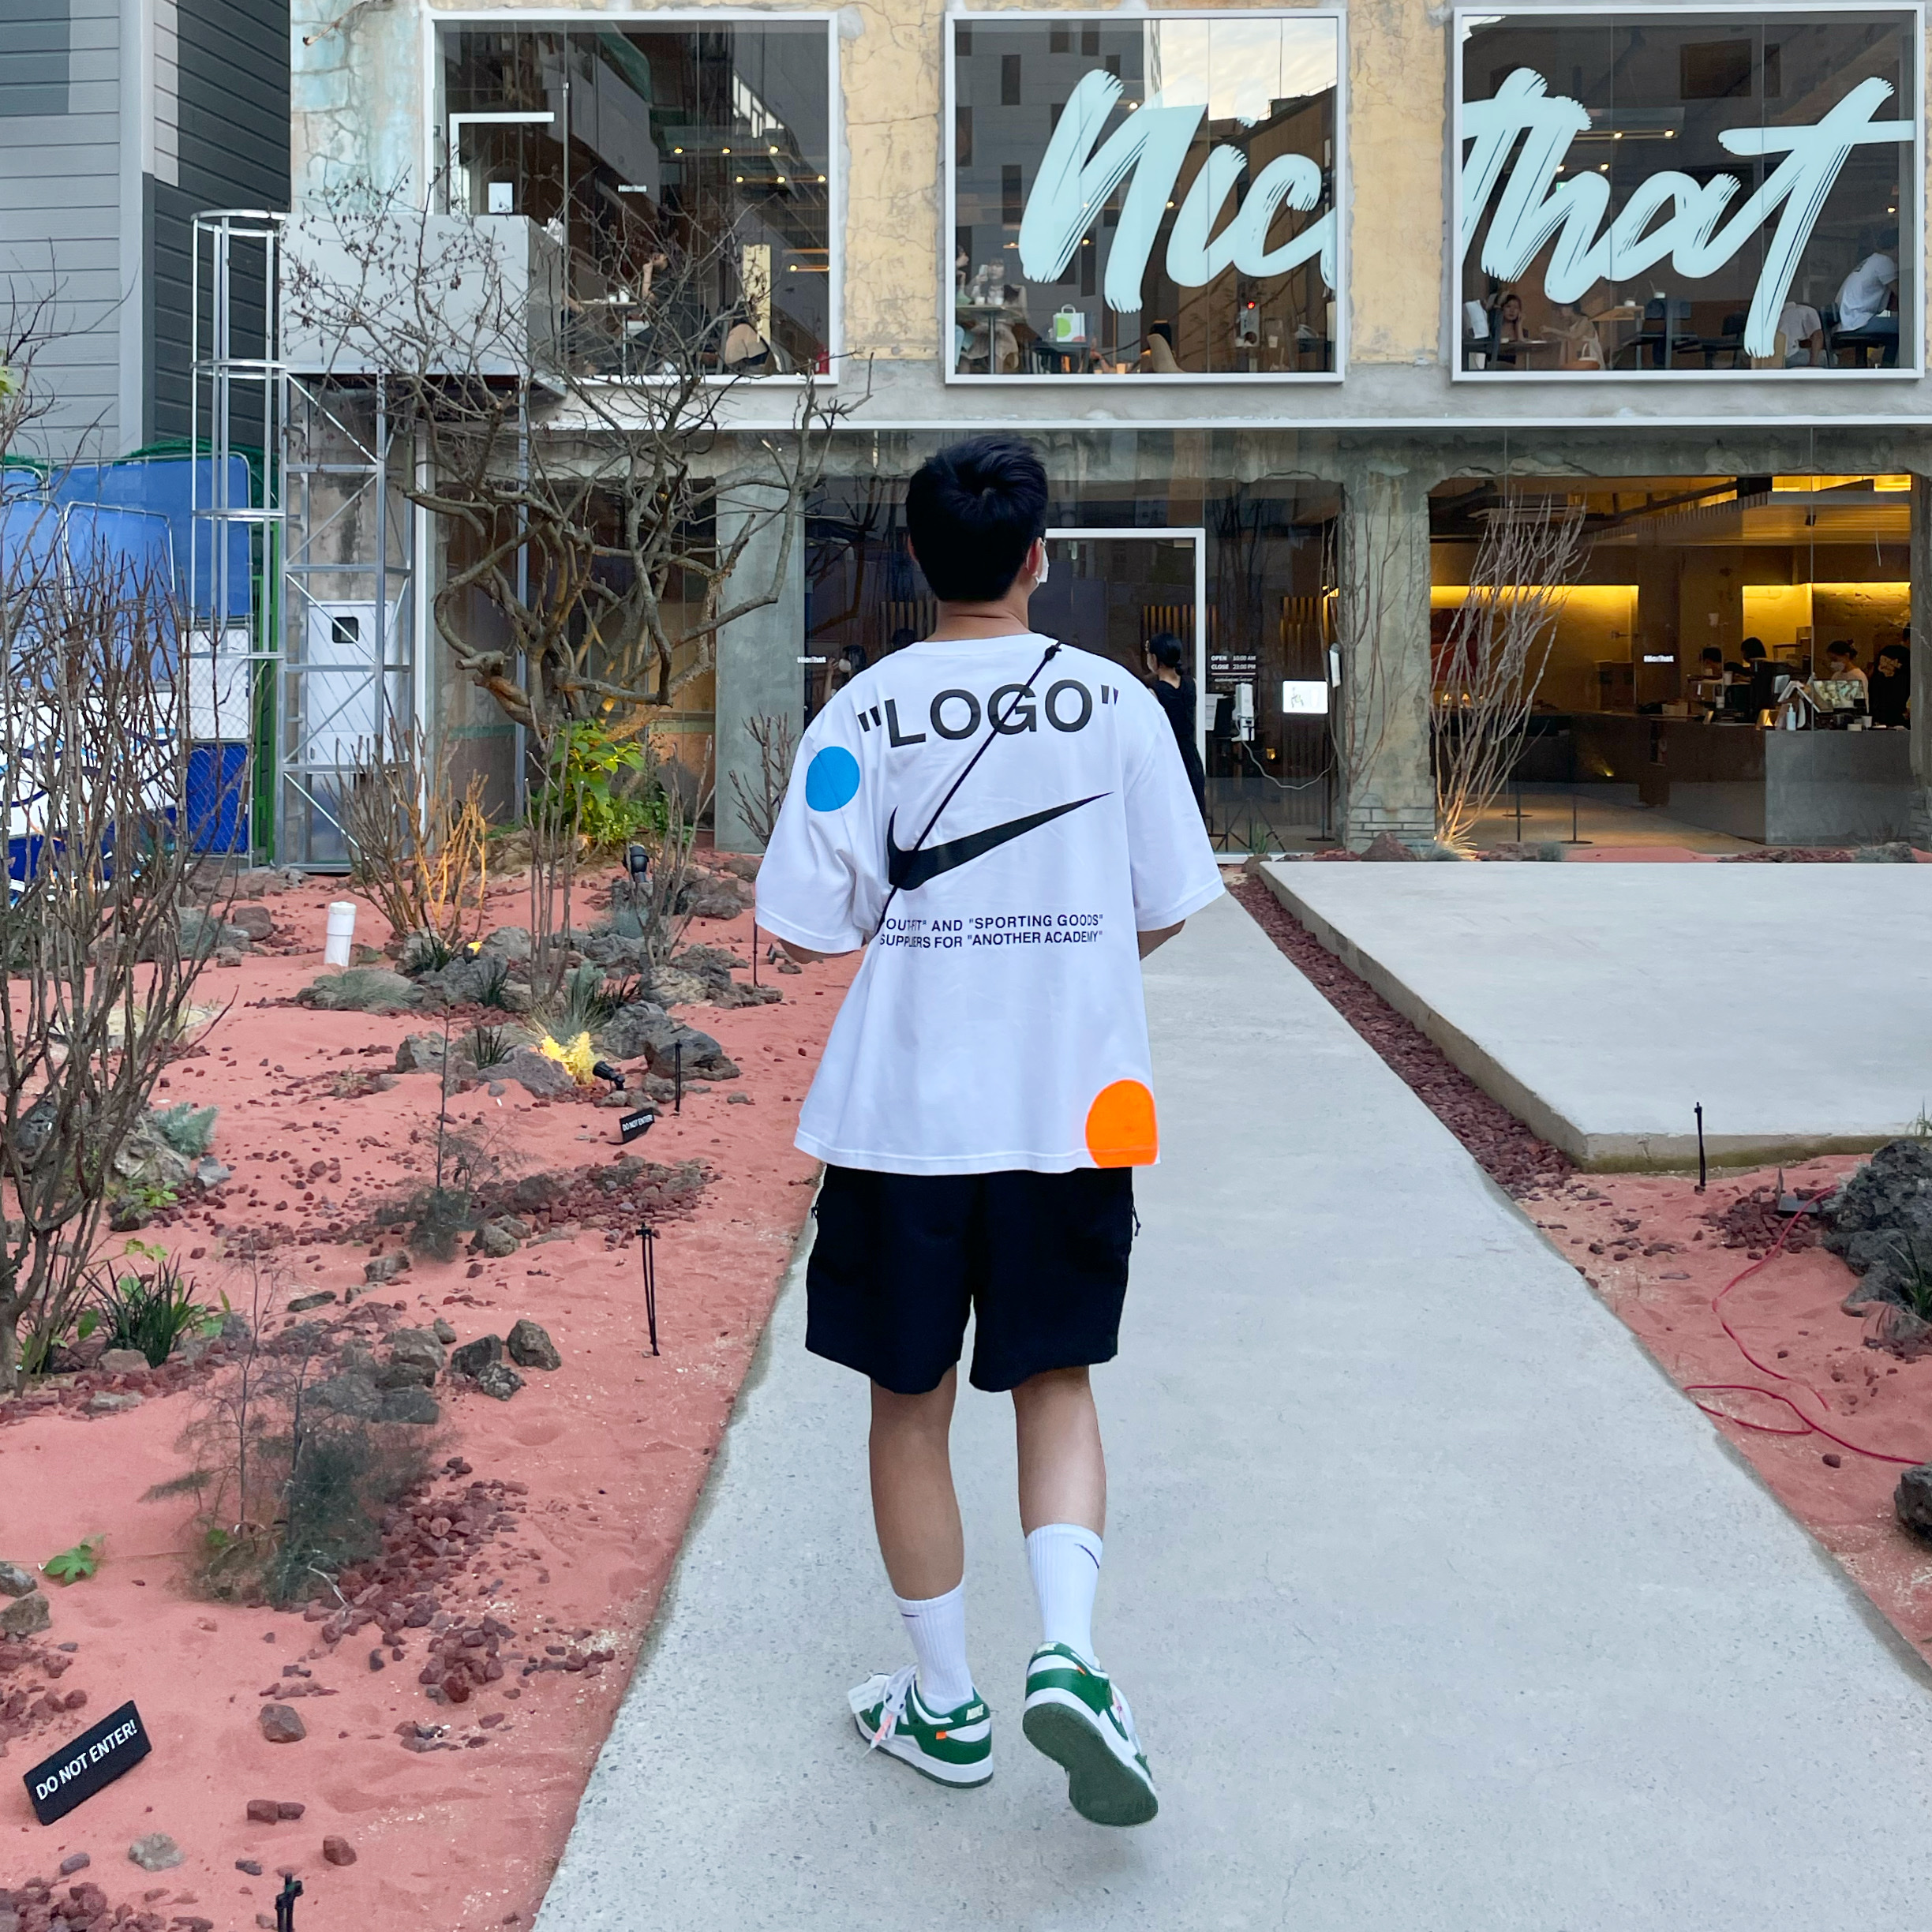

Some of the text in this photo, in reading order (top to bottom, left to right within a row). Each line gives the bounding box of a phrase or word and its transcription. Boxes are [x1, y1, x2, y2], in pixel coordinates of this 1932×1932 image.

[857, 679, 1119, 748] "LOGO"
[931, 919, 963, 931] AND
[969, 915, 1052, 930] "SPORTING
[1058, 914, 1103, 927] GOODS"
[934, 936, 962, 948] FOR
[968, 932, 1041, 945] "ANOTHER
[1044, 930, 1103, 944] ACADEMY"
[36, 1719, 137, 1800] DO NOT ENTER!
